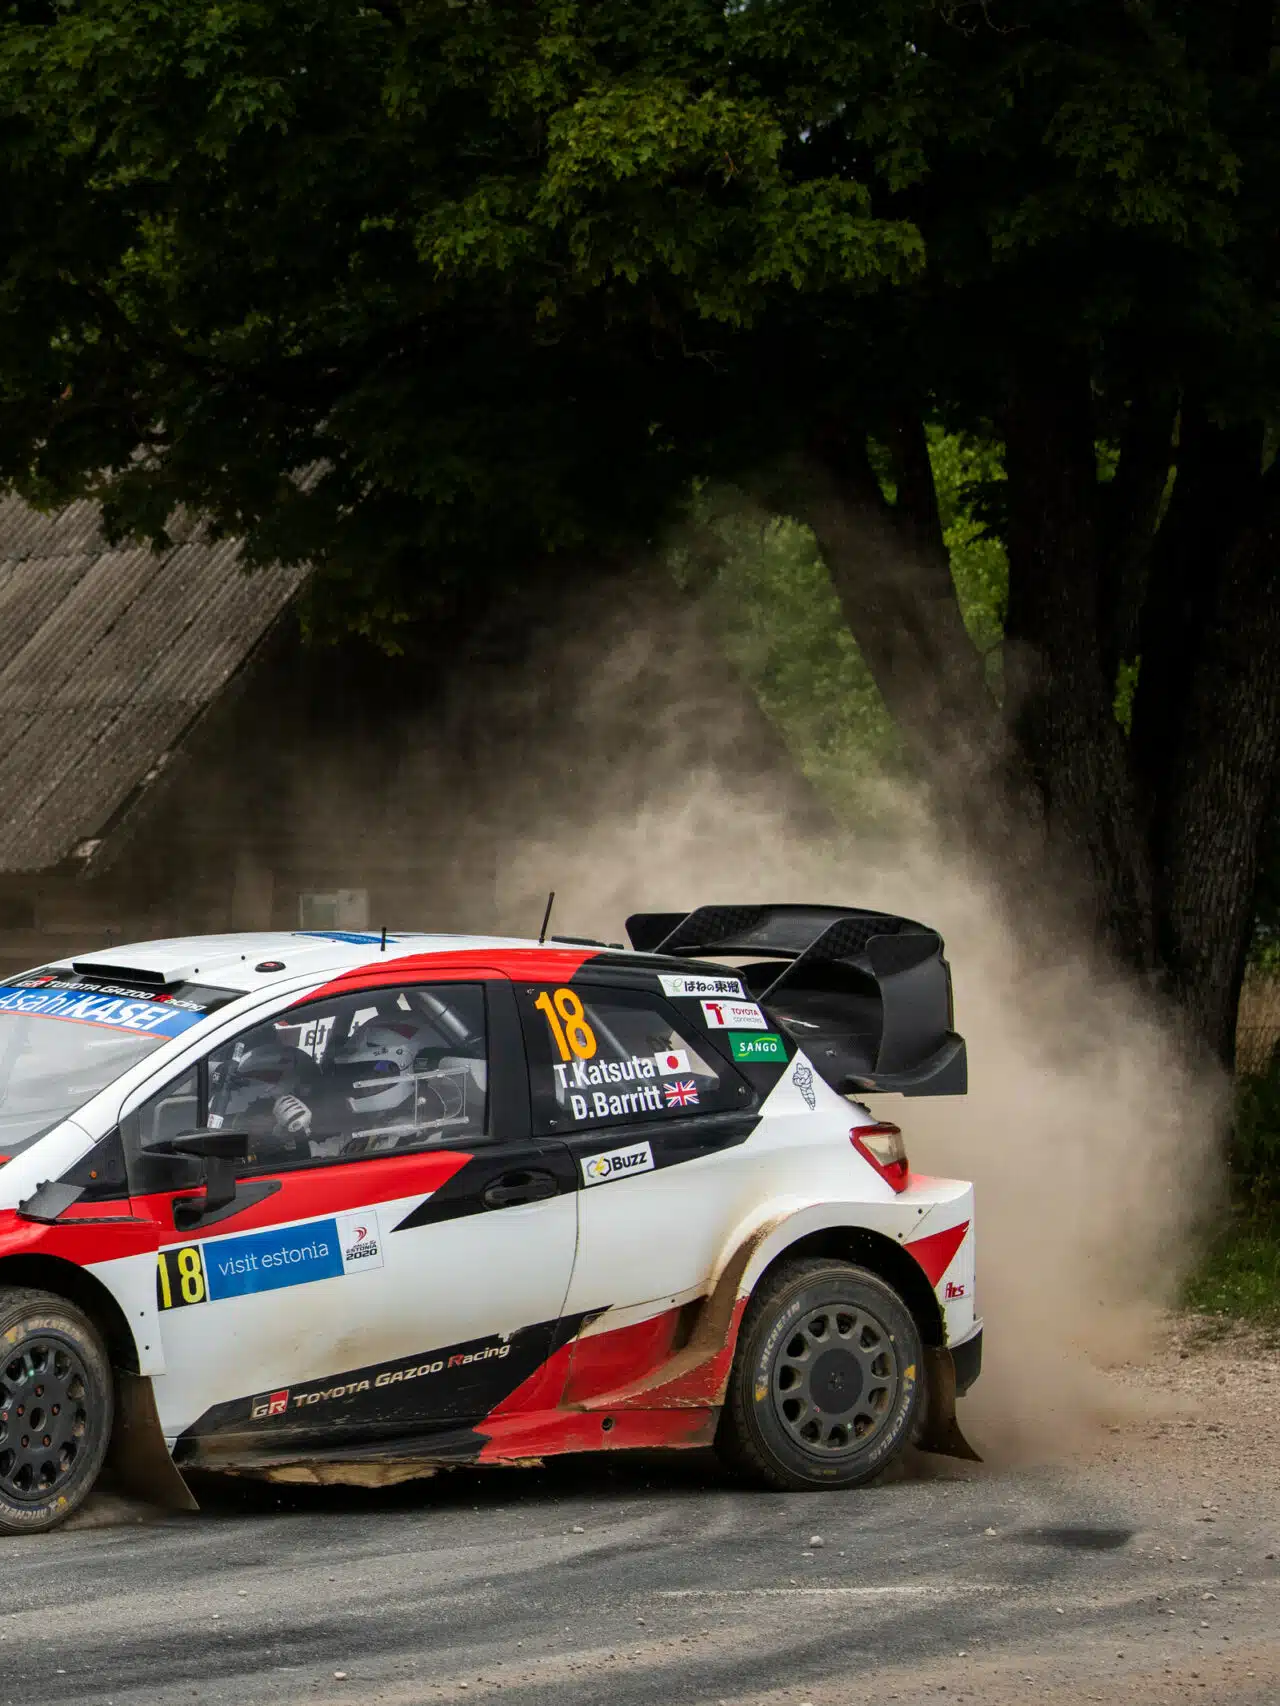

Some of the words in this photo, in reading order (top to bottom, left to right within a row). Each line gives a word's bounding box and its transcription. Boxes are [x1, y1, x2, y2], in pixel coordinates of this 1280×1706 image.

[534, 988, 598, 1062] 18
[731, 1007, 759, 1017] TOYOTA
[739, 1041, 778, 1053] SANGO
[553, 1055, 656, 1089] T.Katsuta
[570, 1085, 664, 1121] D.Barritt
[218, 1253, 260, 1277] visit
[261, 1241, 329, 1269] estonia
[346, 1248, 378, 1261] 2020
[156, 1247, 206, 1308] 18
[252, 1400, 287, 1419] GR
[293, 1379, 371, 1408] TOYOTA
[374, 1361, 445, 1389] GAZOO
[446, 1344, 511, 1369] Racing
